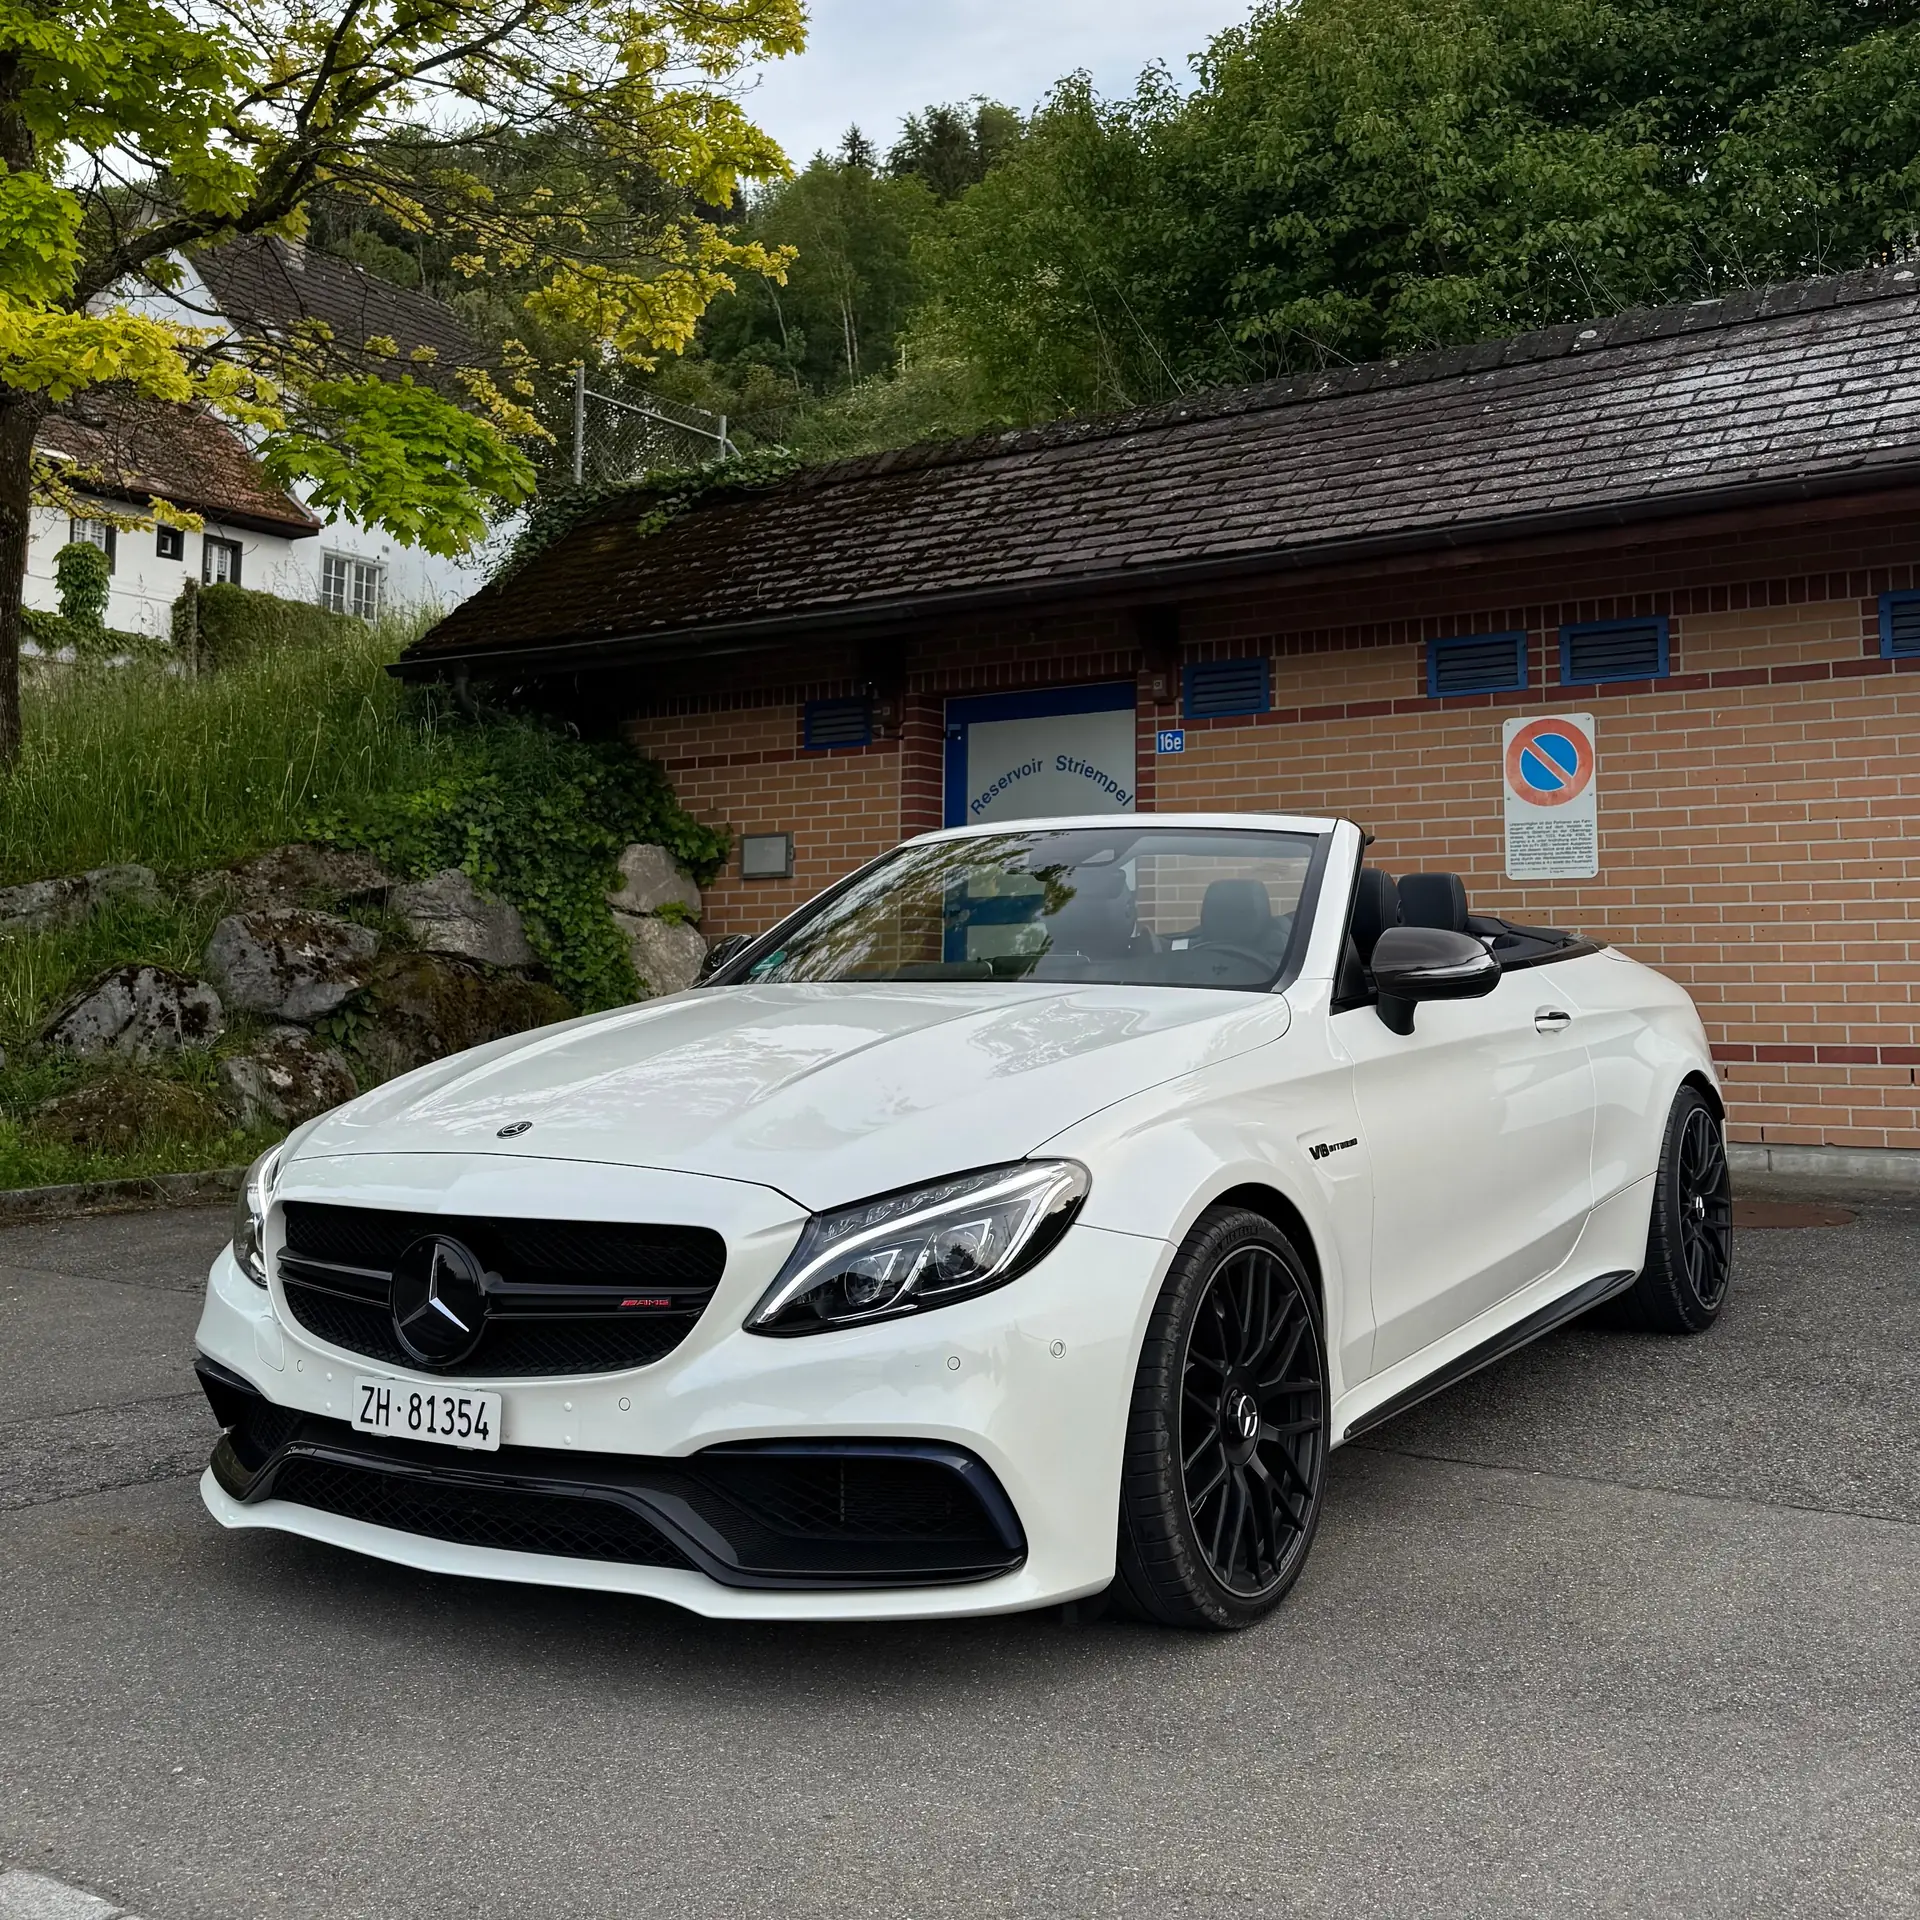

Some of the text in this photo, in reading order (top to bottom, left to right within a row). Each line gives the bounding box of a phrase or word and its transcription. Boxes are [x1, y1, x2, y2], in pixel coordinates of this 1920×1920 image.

[1159, 733, 1182, 750] 16e
[970, 755, 1134, 815] Reservoir Striempel
[1309, 1143, 1330, 1160] V8
